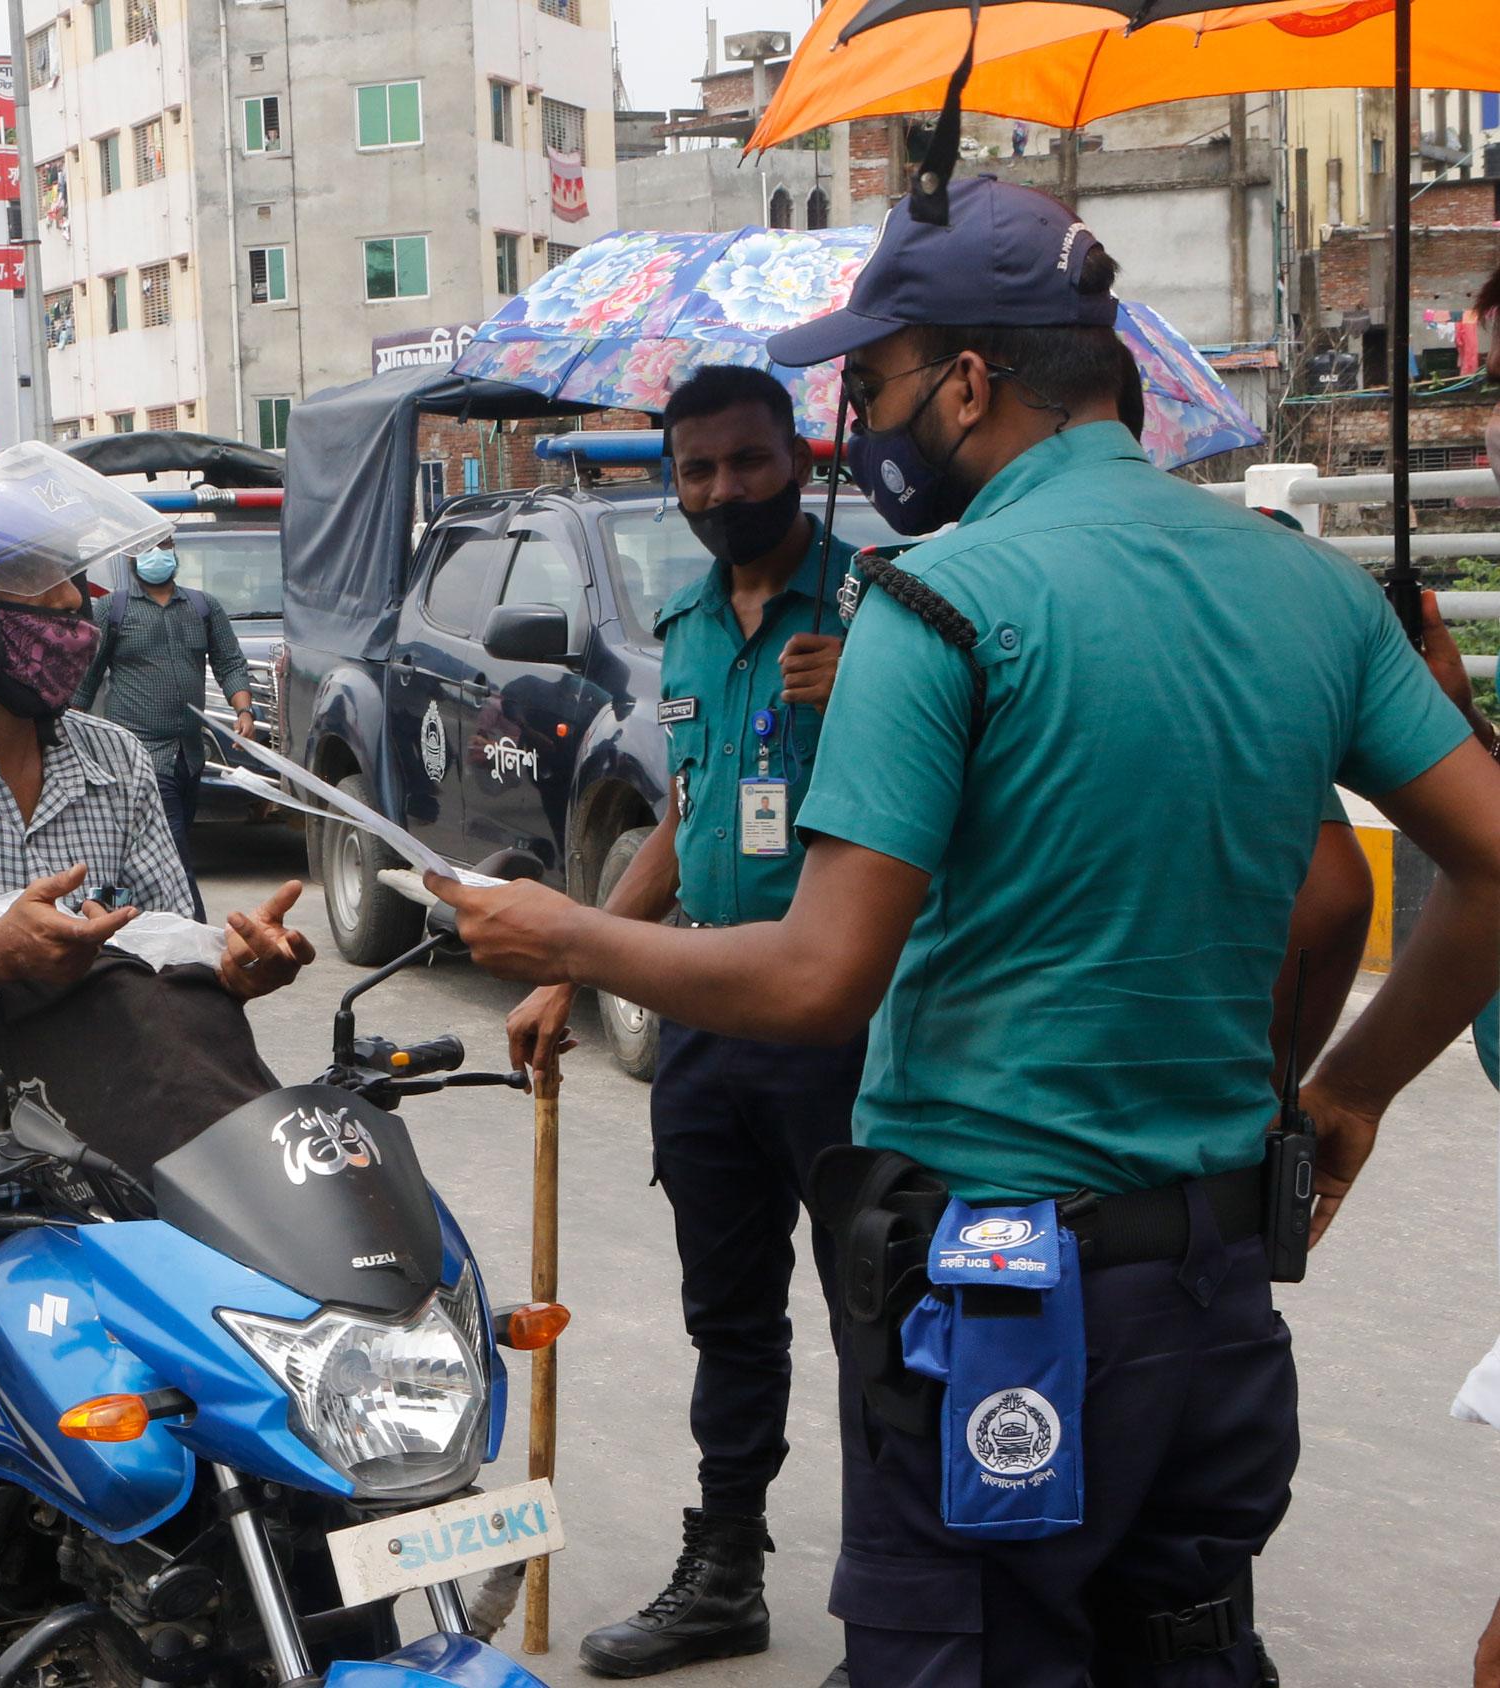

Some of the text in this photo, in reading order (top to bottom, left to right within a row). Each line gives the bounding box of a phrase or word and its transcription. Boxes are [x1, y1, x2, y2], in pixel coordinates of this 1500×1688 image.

[483, 736, 538, 784] পুলিশ
[939, 1254, 1047, 1272] একটি UCB প্রতিষ্ঠান
[980, 1467, 1057, 1491] বাংলাদেশ পুলিশ
[399, 1499, 549, 1570] SUZUKI
